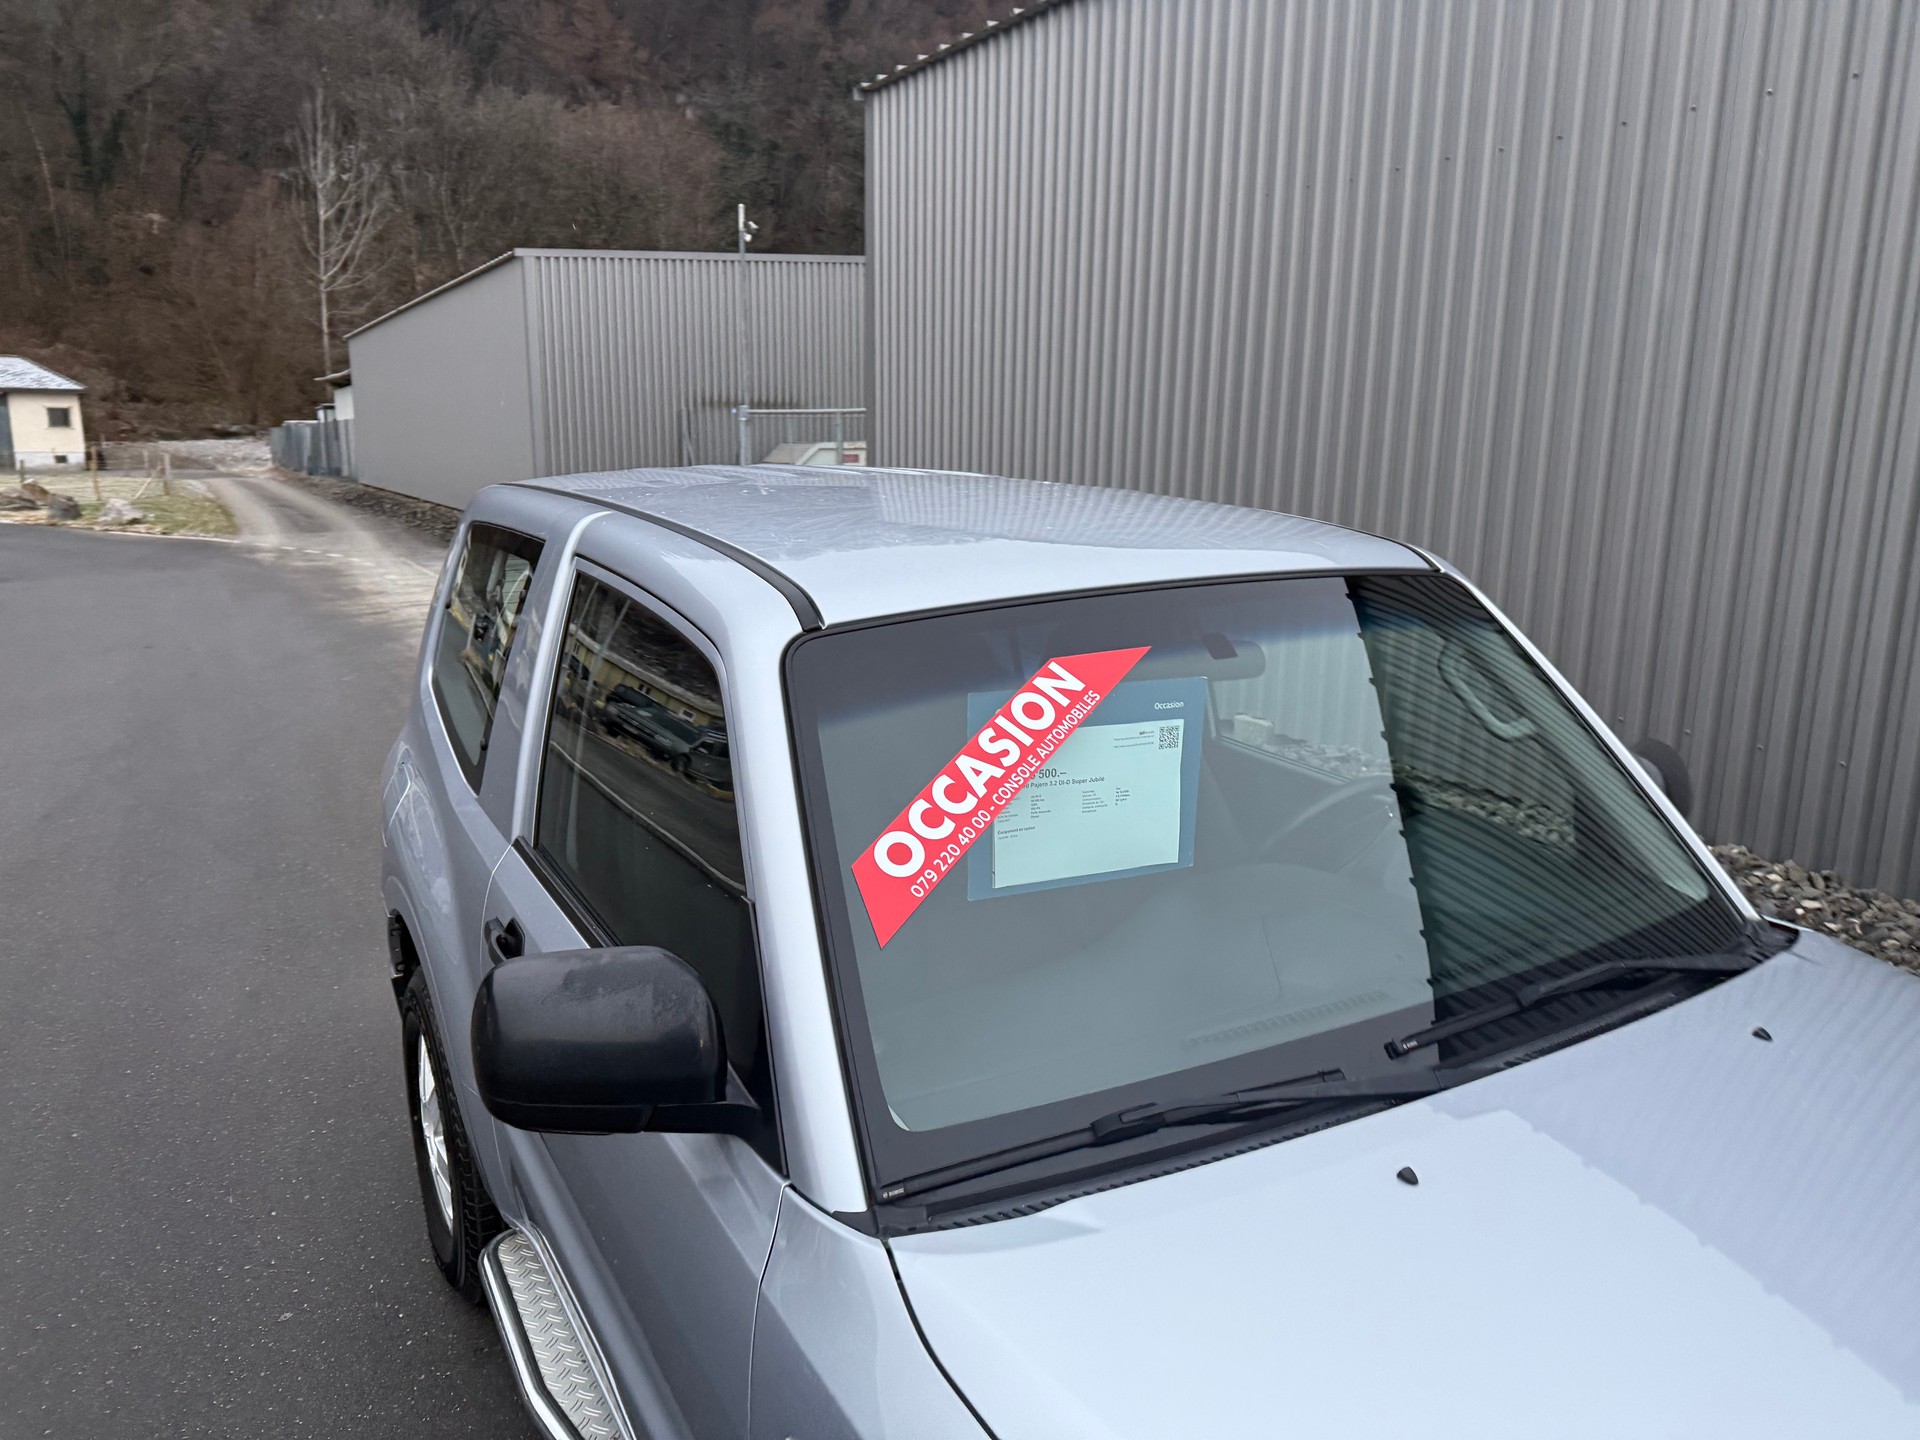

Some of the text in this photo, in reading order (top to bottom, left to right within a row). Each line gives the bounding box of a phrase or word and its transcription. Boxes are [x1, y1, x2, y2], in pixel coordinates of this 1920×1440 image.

[873, 661, 1086, 878] OCCASION
[910, 869, 938, 898] 079
[933, 844, 961, 872] 220
[958, 826, 977, 847] 40
[971, 809, 992, 829] 00
[992, 754, 1042, 806] CONSOLE
[1037, 689, 1101, 760] AUTOMOBILES
[1154, 701, 1184, 710] Occasion
